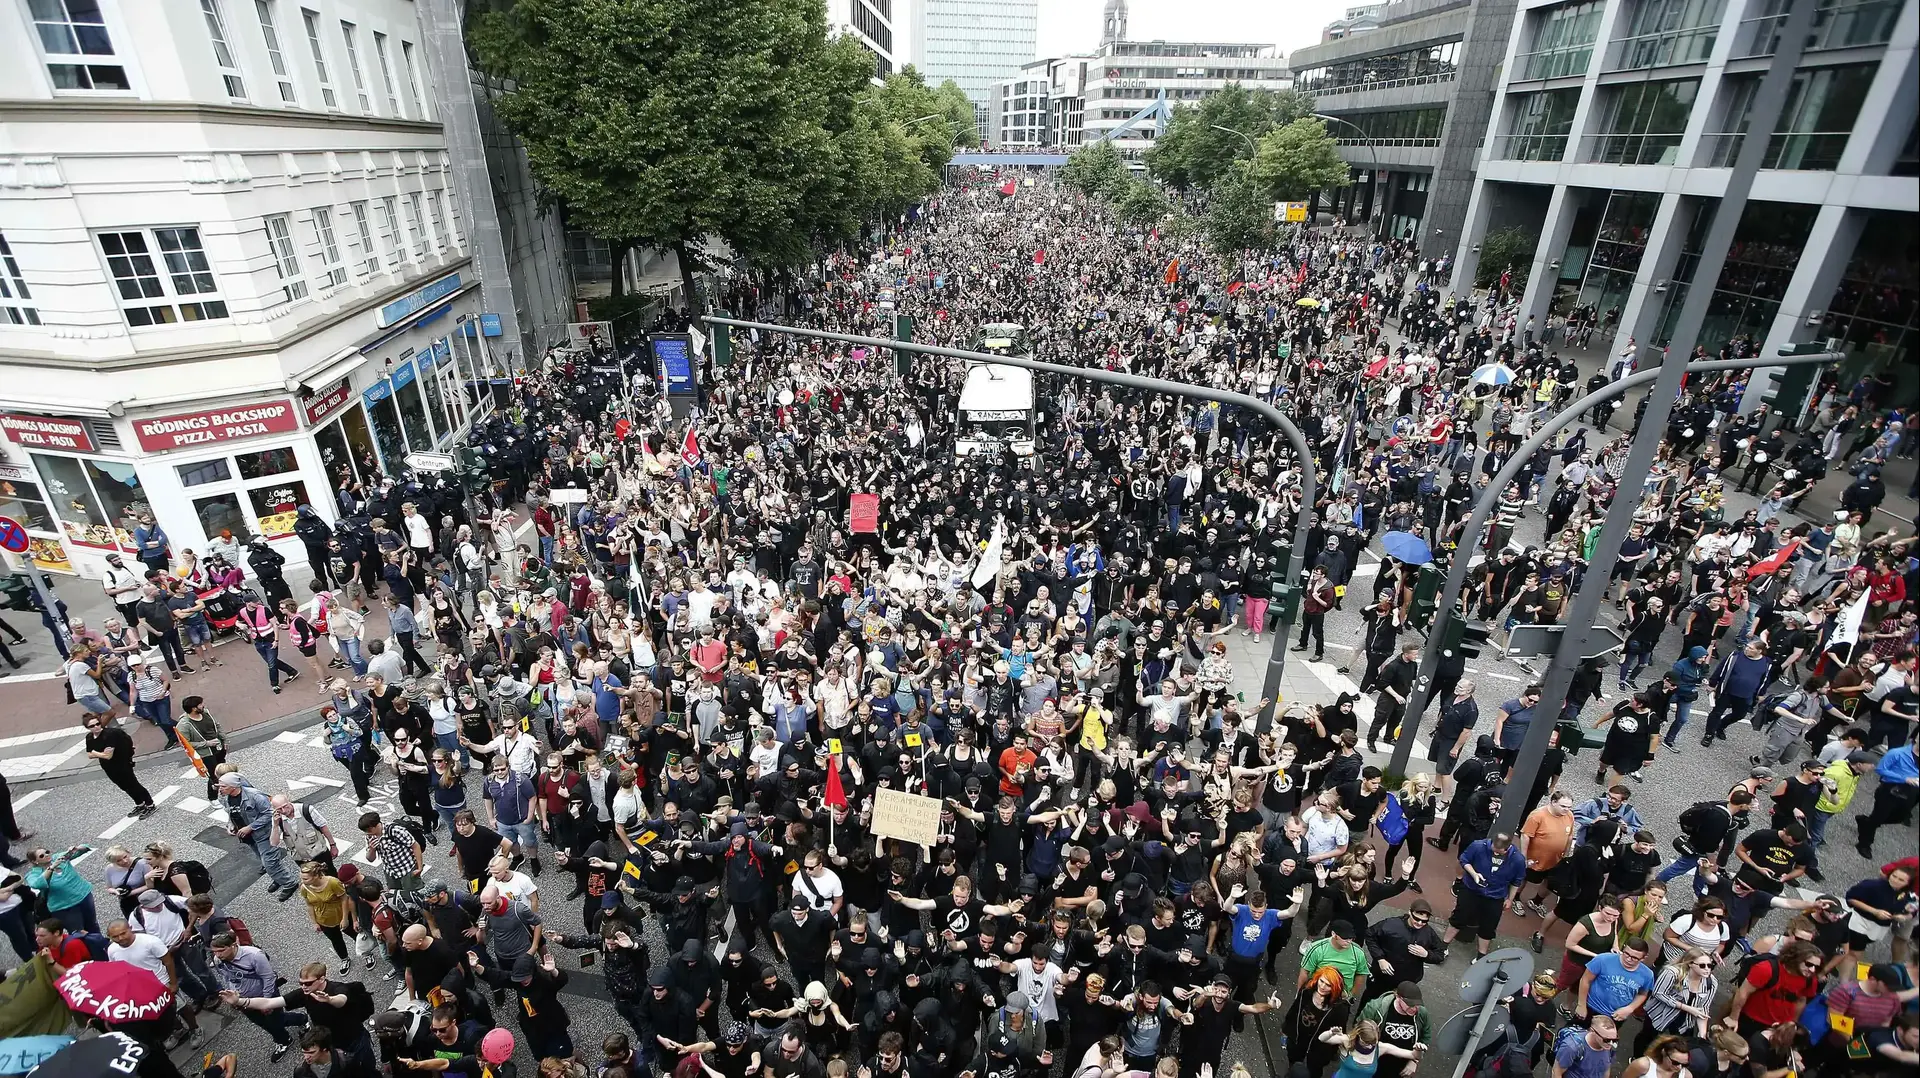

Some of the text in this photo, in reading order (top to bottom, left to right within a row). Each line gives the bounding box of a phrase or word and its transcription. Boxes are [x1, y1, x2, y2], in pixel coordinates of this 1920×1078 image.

[1115, 78, 1147, 88] Holcim
[304, 391, 324, 410] RÖDINGS
[314, 402, 328, 418] PIZZA
[328, 393, 342, 408] PASTA
[1, 416, 82, 435] RÖDINGS BACKSHOP
[142, 405, 286, 436] RÖDINGS BACKSHOP
[19, 432, 45, 443] PIZZA
[49, 435, 78, 448] PASTA
[173, 431, 217, 446] PIZZA
[227, 422, 268, 438] PASTA
[417, 458, 446, 468] Centrum
[273, 488, 293, 498] Coffee
[880, 792, 937, 809] VERSAMMLUNGS
[876, 811, 938, 828] PRESSEFREIHEIT
